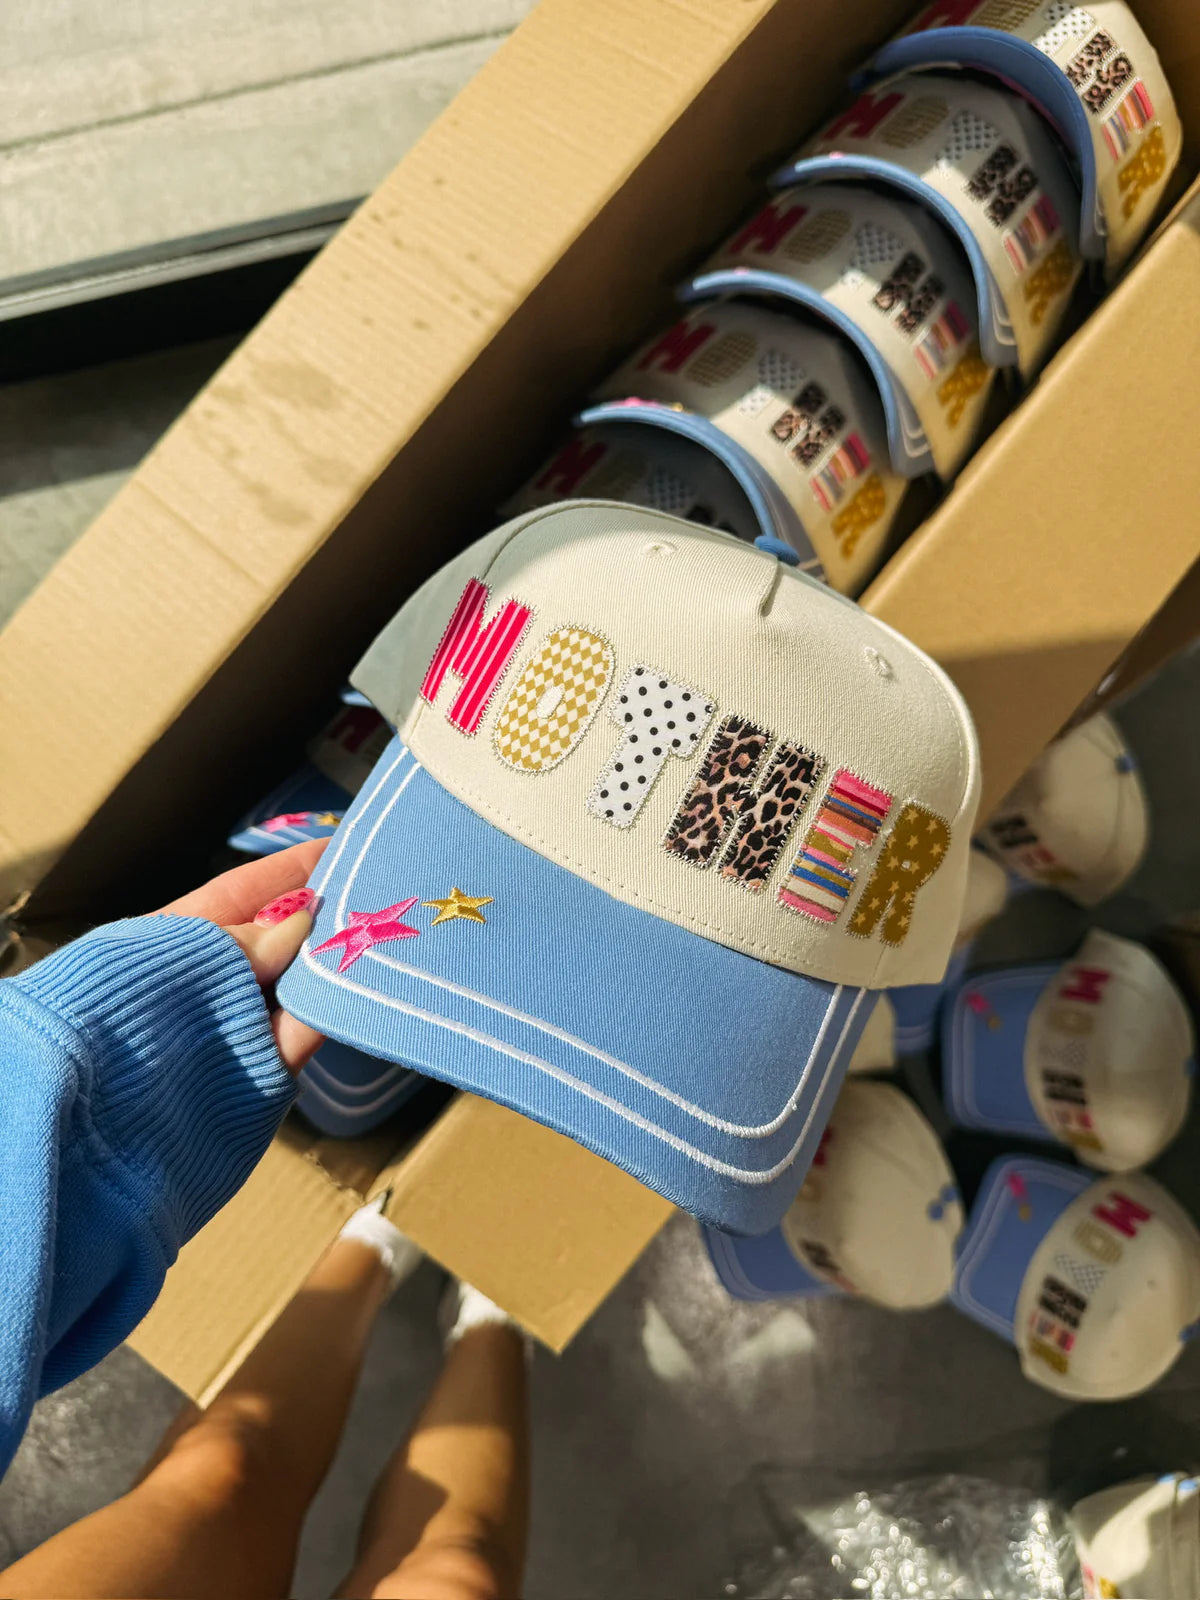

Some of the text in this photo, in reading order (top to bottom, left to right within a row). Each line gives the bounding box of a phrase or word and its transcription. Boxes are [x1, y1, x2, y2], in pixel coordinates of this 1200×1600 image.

[727, 203, 991, 428] MOTHER
[822, 93, 1077, 327] MOTHER
[636, 321, 887, 558] MOTHER
[420, 576, 953, 949] MOTHER
